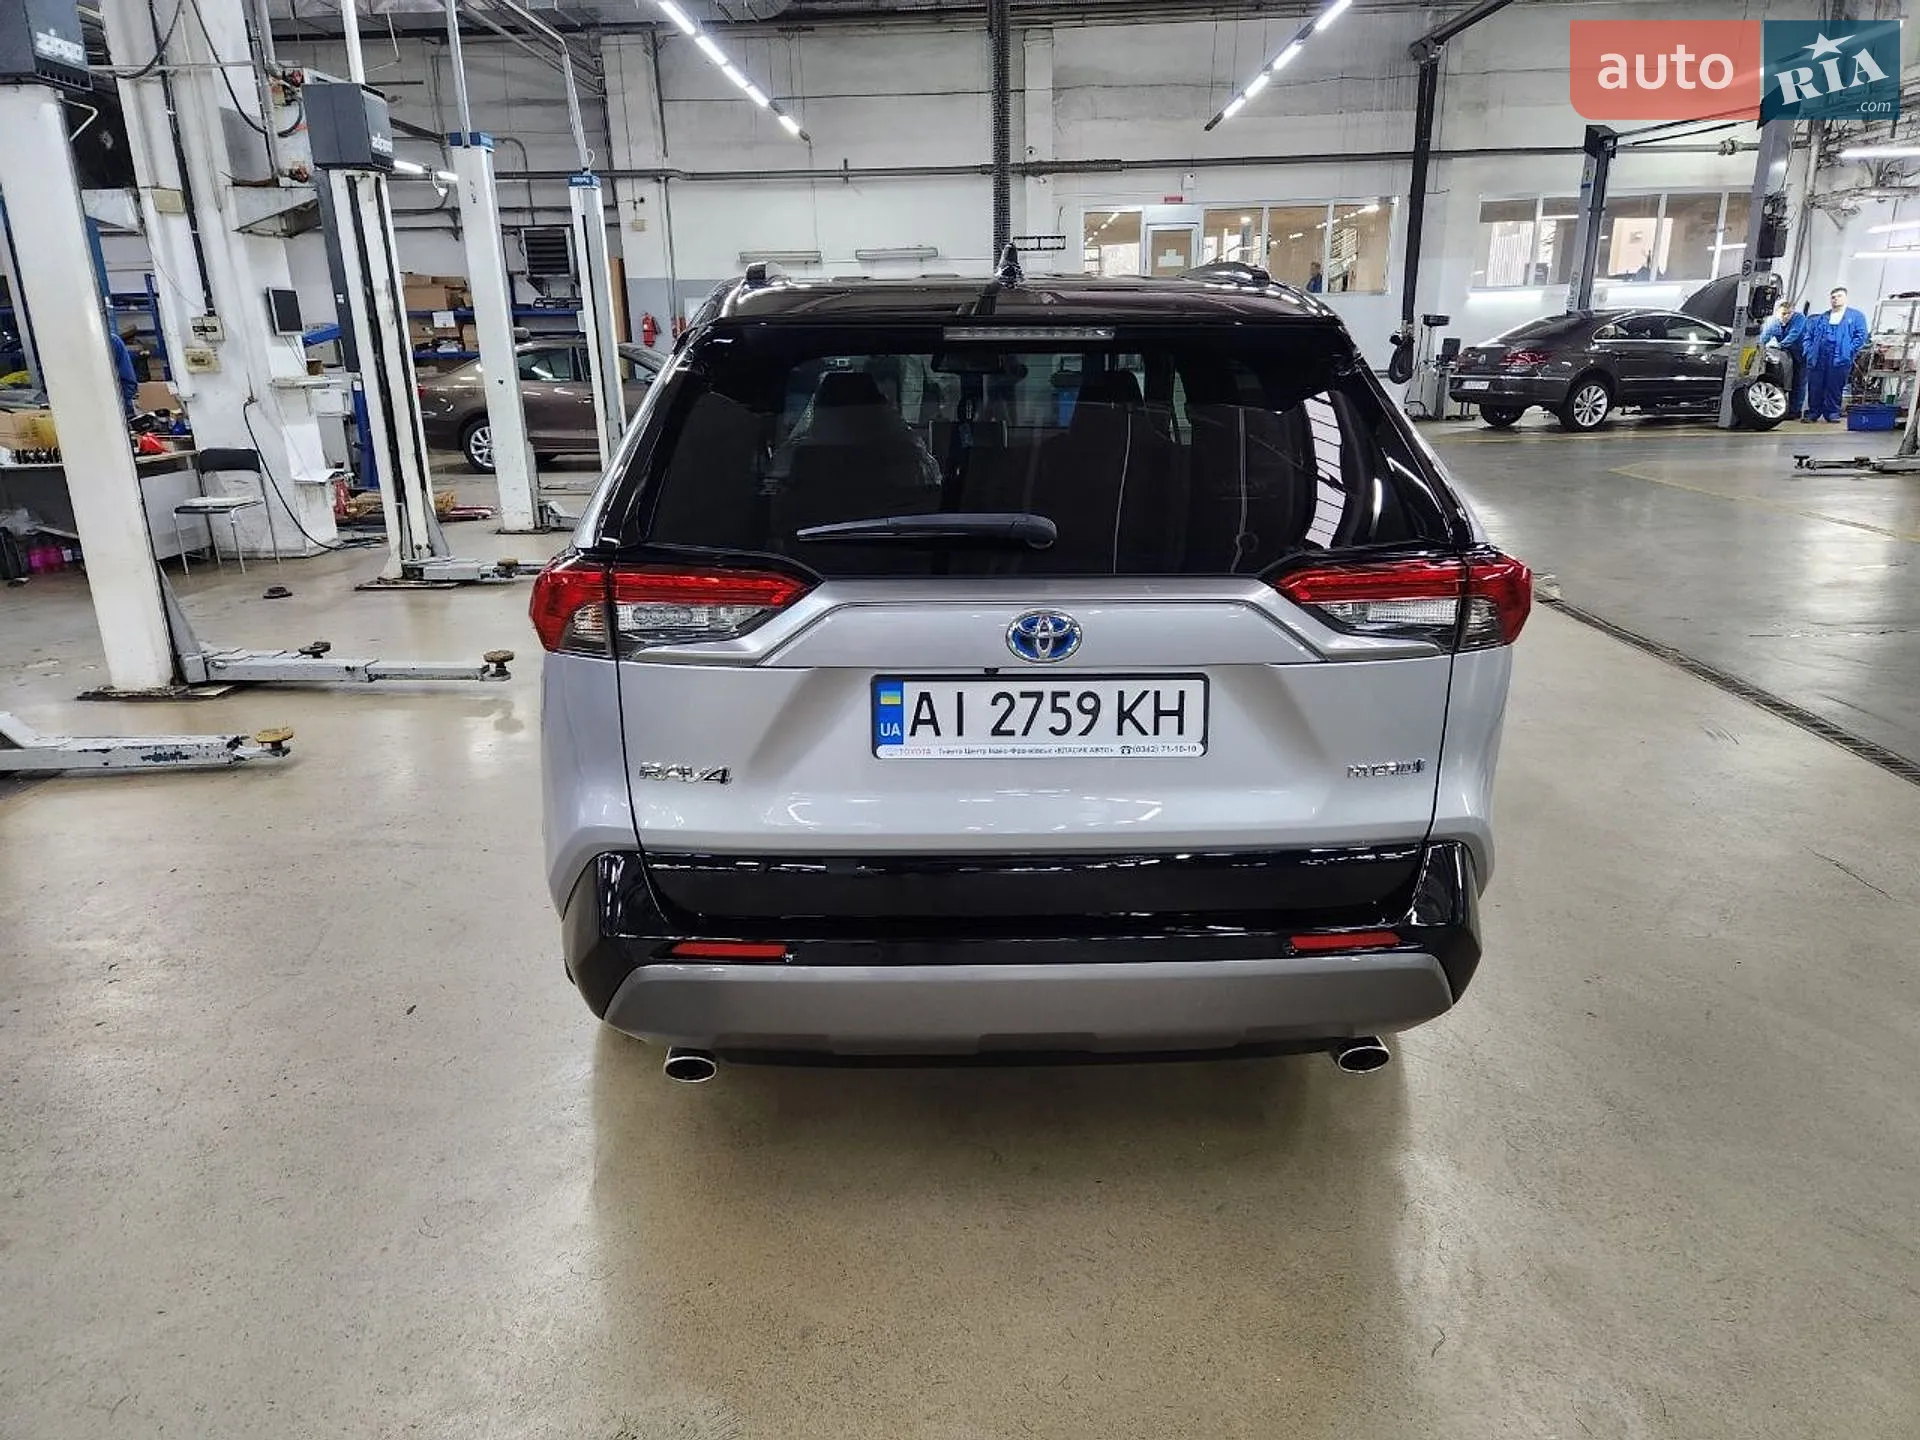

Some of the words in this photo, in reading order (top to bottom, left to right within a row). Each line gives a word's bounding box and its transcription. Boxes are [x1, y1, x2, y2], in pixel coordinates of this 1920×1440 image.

[908, 691, 965, 737] AI
[989, 690, 1102, 737] 2759
[1117, 689, 1186, 737] KH
[880, 722, 902, 737] UA
